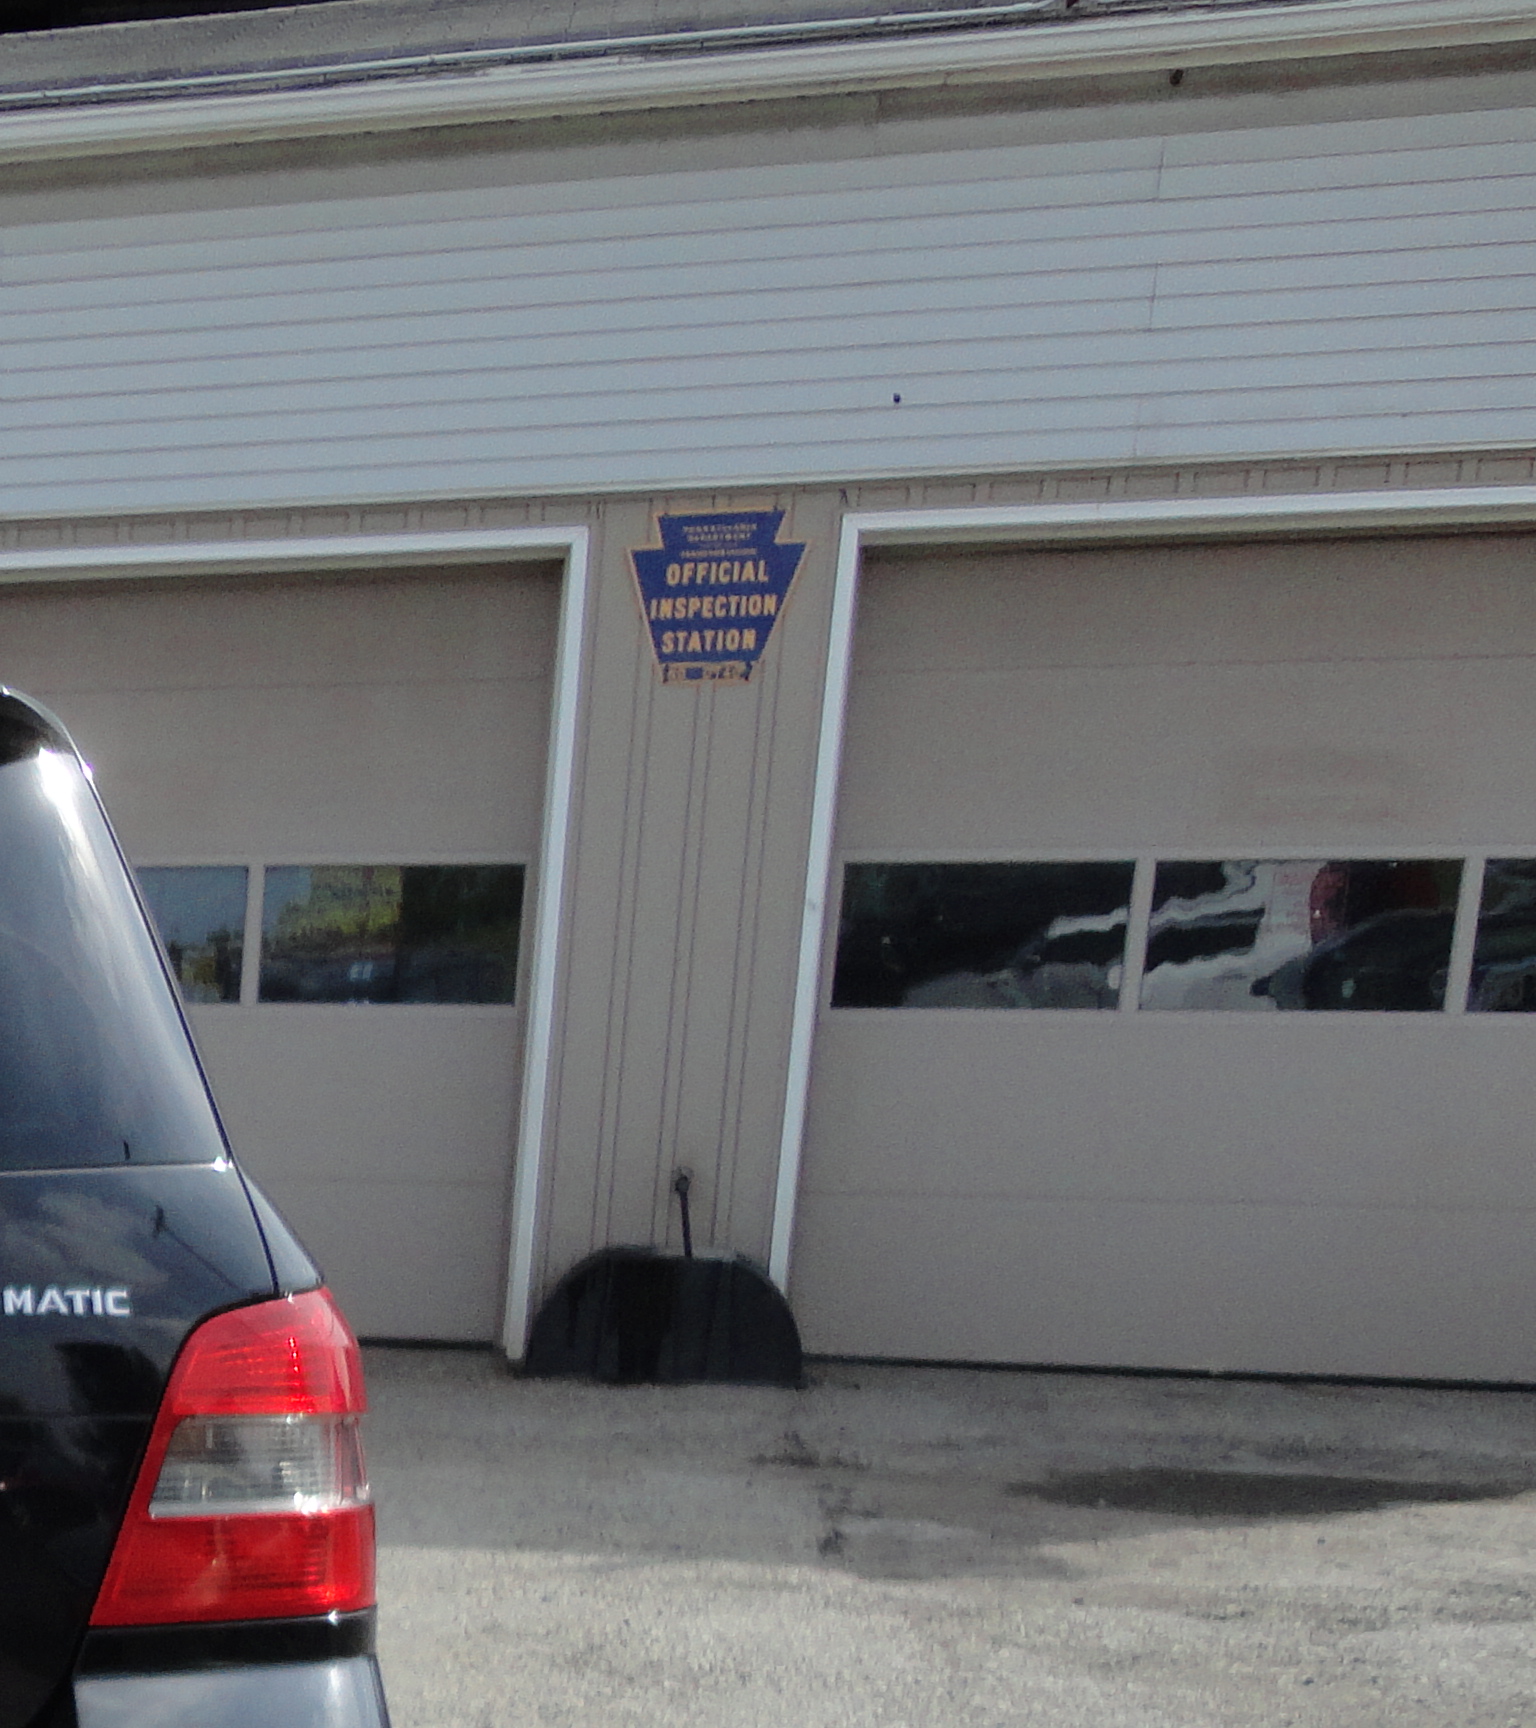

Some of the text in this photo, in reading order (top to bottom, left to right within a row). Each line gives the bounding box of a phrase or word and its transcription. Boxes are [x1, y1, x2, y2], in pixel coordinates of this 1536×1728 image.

[665, 560, 770, 587] OFFICIAL
[649, 594, 779, 620] INSPECTION
[661, 628, 757, 653] STATION
